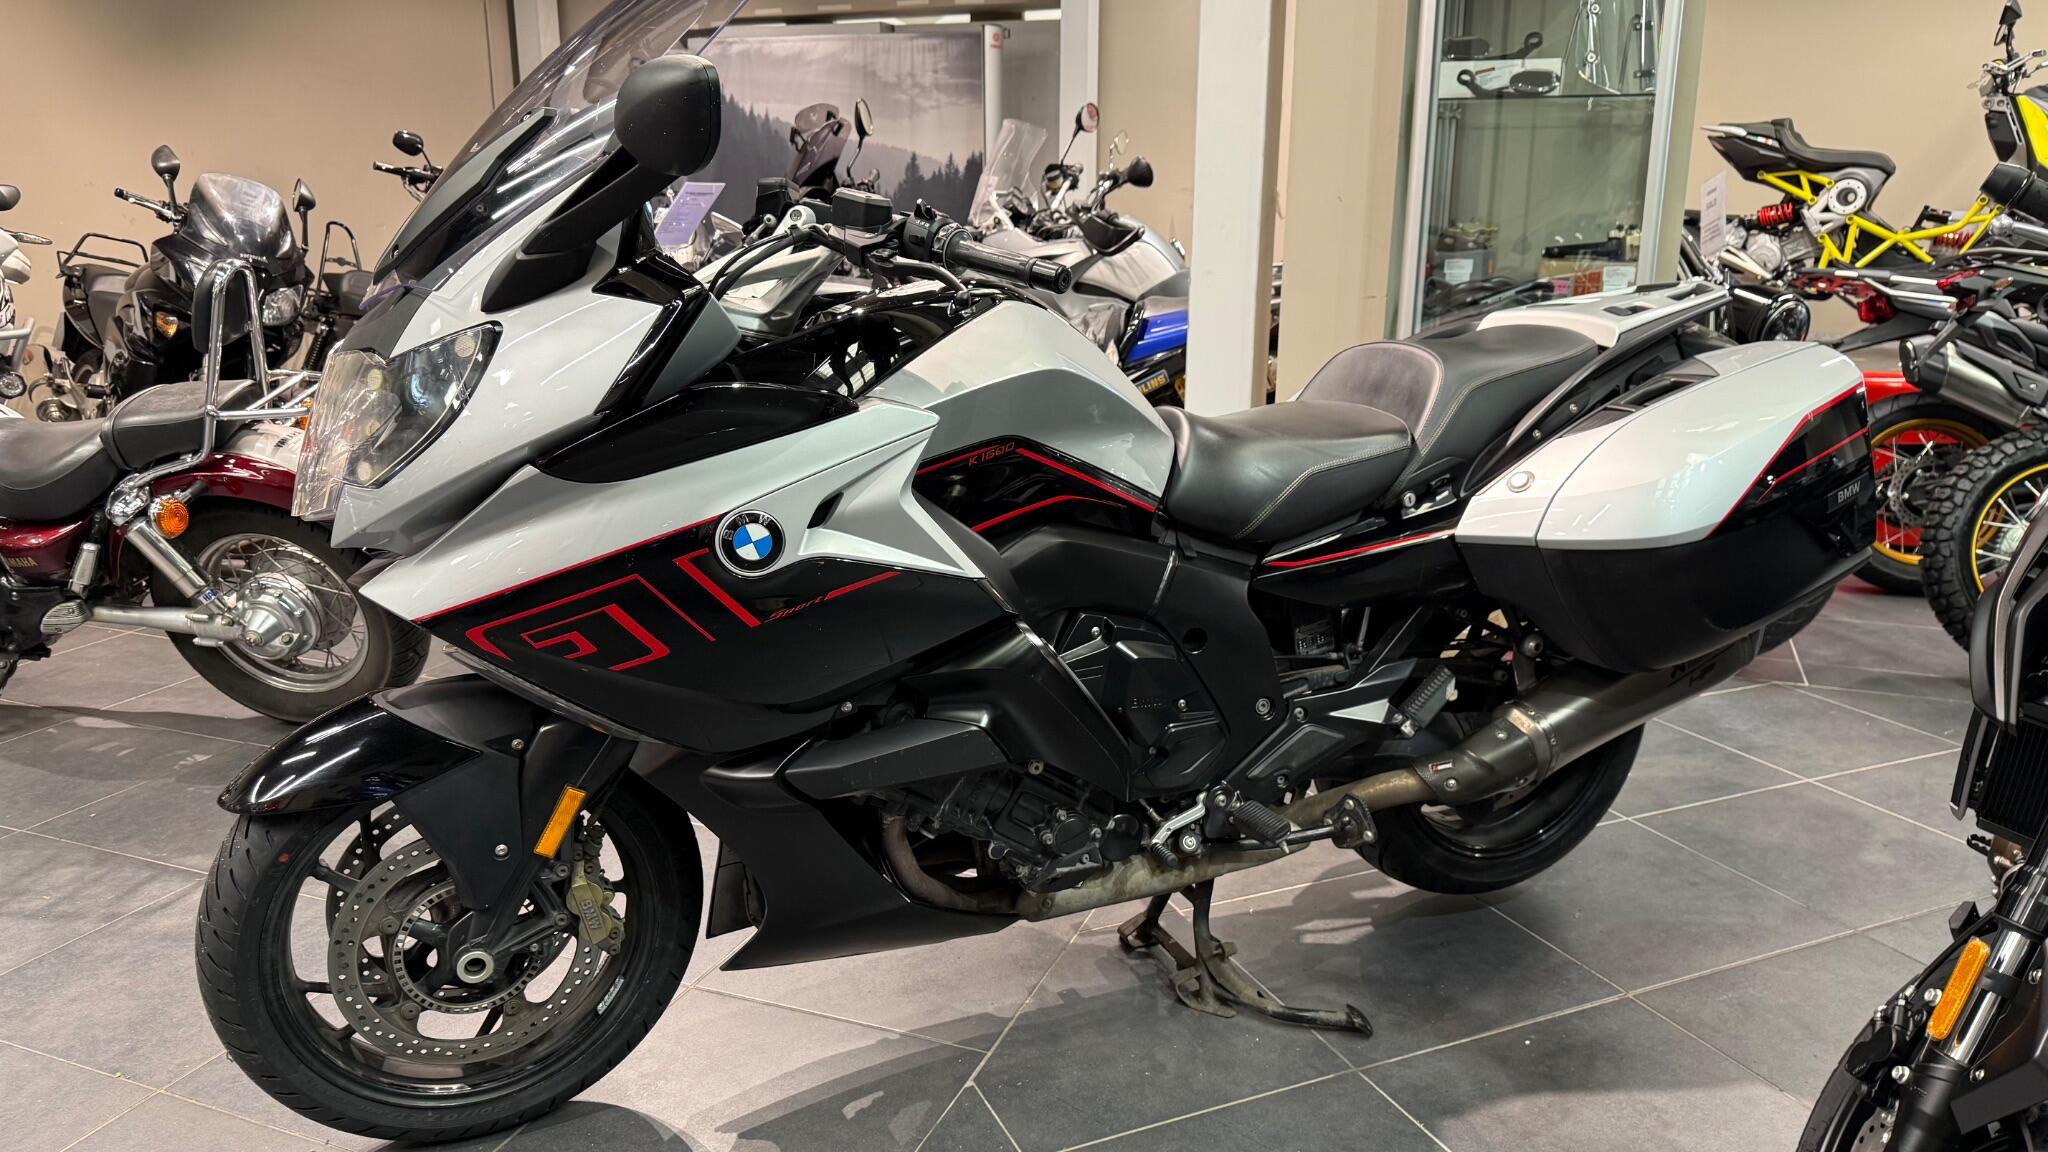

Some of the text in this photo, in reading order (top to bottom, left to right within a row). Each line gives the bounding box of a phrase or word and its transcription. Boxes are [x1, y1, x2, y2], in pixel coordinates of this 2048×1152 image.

[1138, 373, 1166, 393] LINS
[1837, 480, 1861, 504] BMW
[723, 514, 772, 541] BMW
[7, 556, 38, 568] MAHA
[764, 596, 825, 622] Sport
[580, 899, 602, 929] BMW
